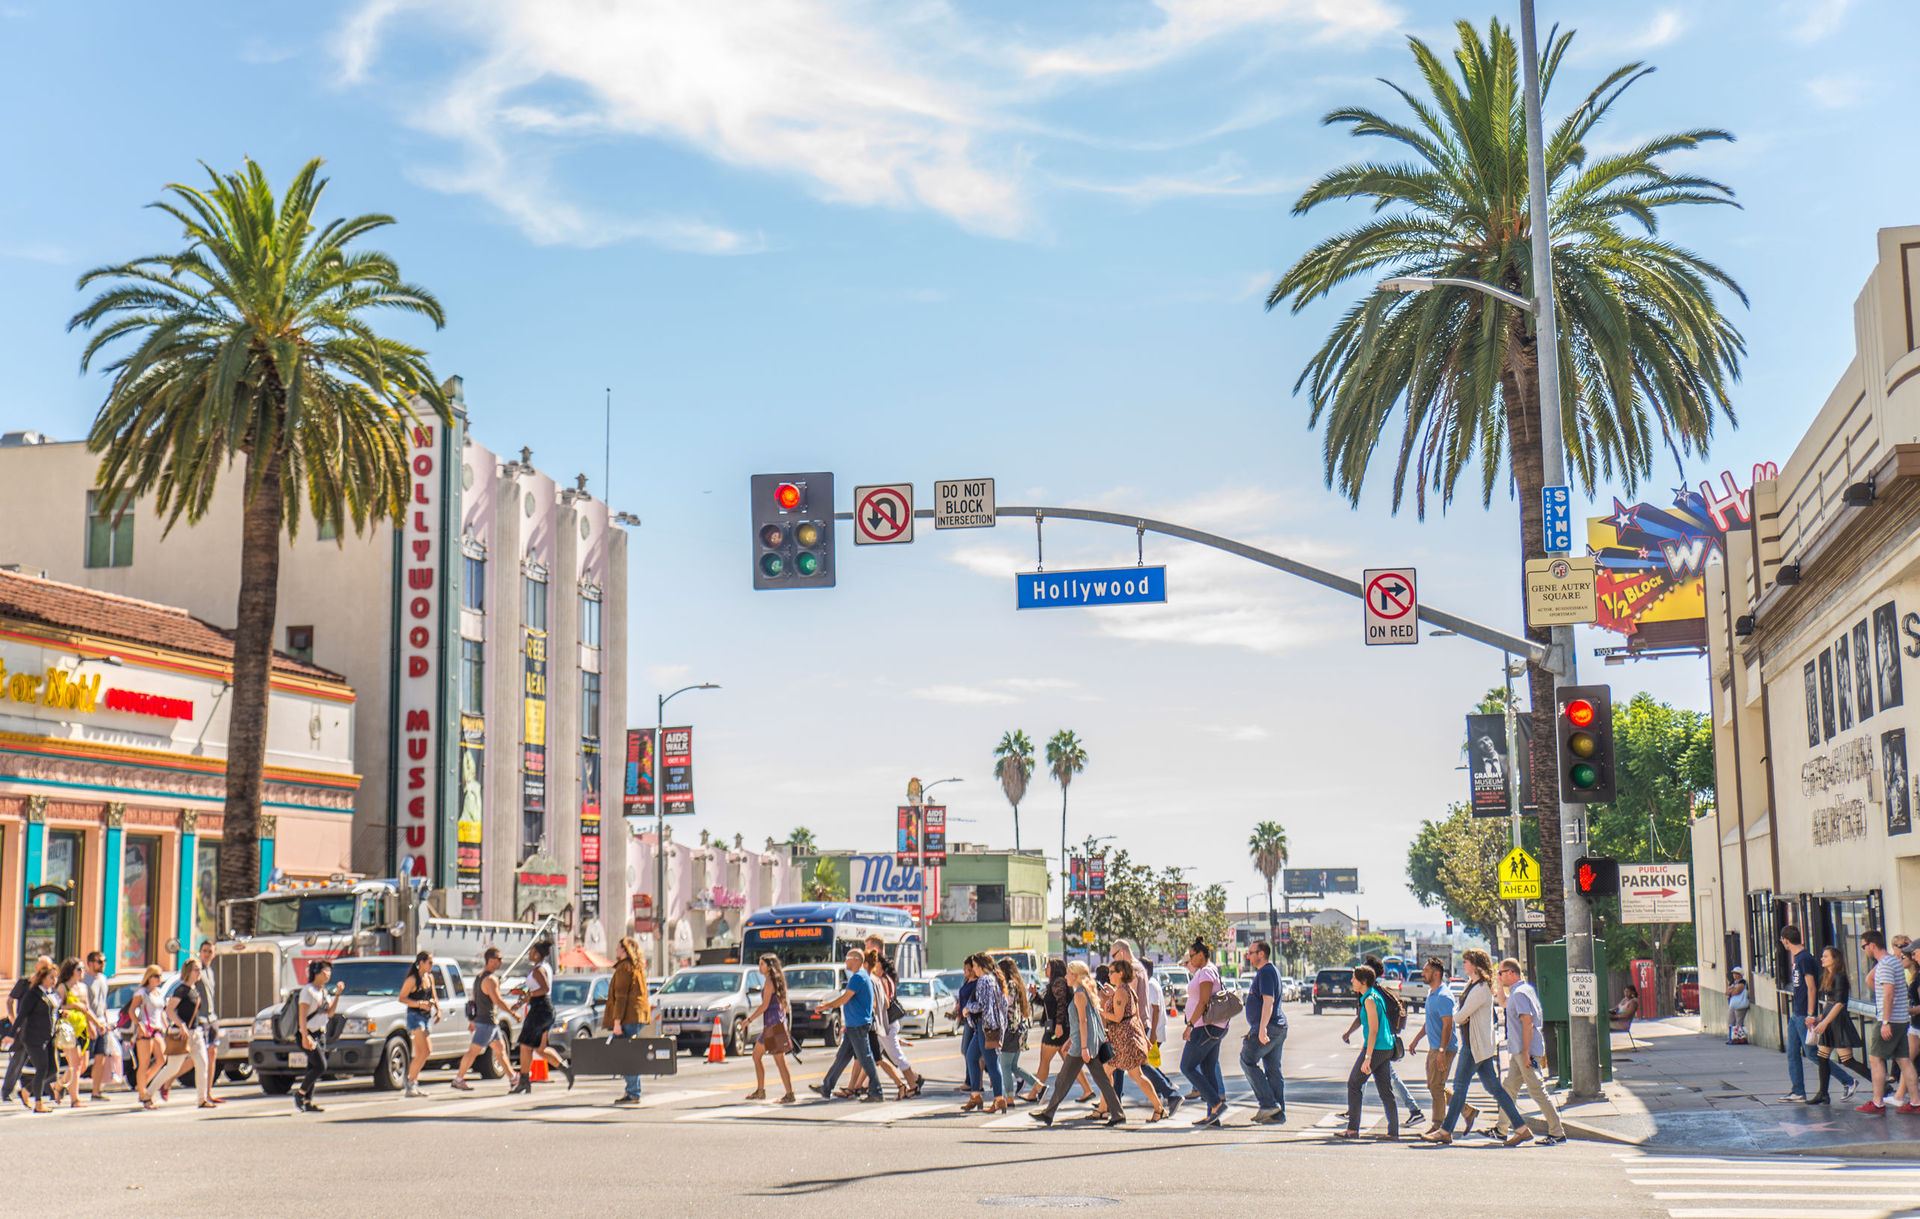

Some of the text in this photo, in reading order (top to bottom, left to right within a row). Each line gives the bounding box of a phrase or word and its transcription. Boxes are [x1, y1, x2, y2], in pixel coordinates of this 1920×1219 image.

[942, 483, 986, 498] DO NOT
[946, 500, 983, 514] BLOCK
[937, 514, 993, 525] INTERSECTION
[1554, 490, 1569, 548] SYNC
[408, 426, 433, 678] HOLLYWOOD
[1033, 576, 1149, 602] Hollywood
[1531, 582, 1591, 593] GENE AUTRY
[1624, 574, 1664, 604] BLOCK
[1542, 591, 1581, 601] SQUARE
[1369, 624, 1414, 638] ON RED
[8, 672, 43, 704] or
[42, 666, 101, 714] Not!
[666, 732, 688, 742] AIDS
[666, 742, 688, 750] WALK
[405, 709, 430, 877] MUSEUM
[850, 855, 928, 893] Mels
[1621, 874, 1687, 887] PARKING
[1504, 884, 1537, 894] AHEAD
[856, 894, 919, 903] DRIVE-IN
